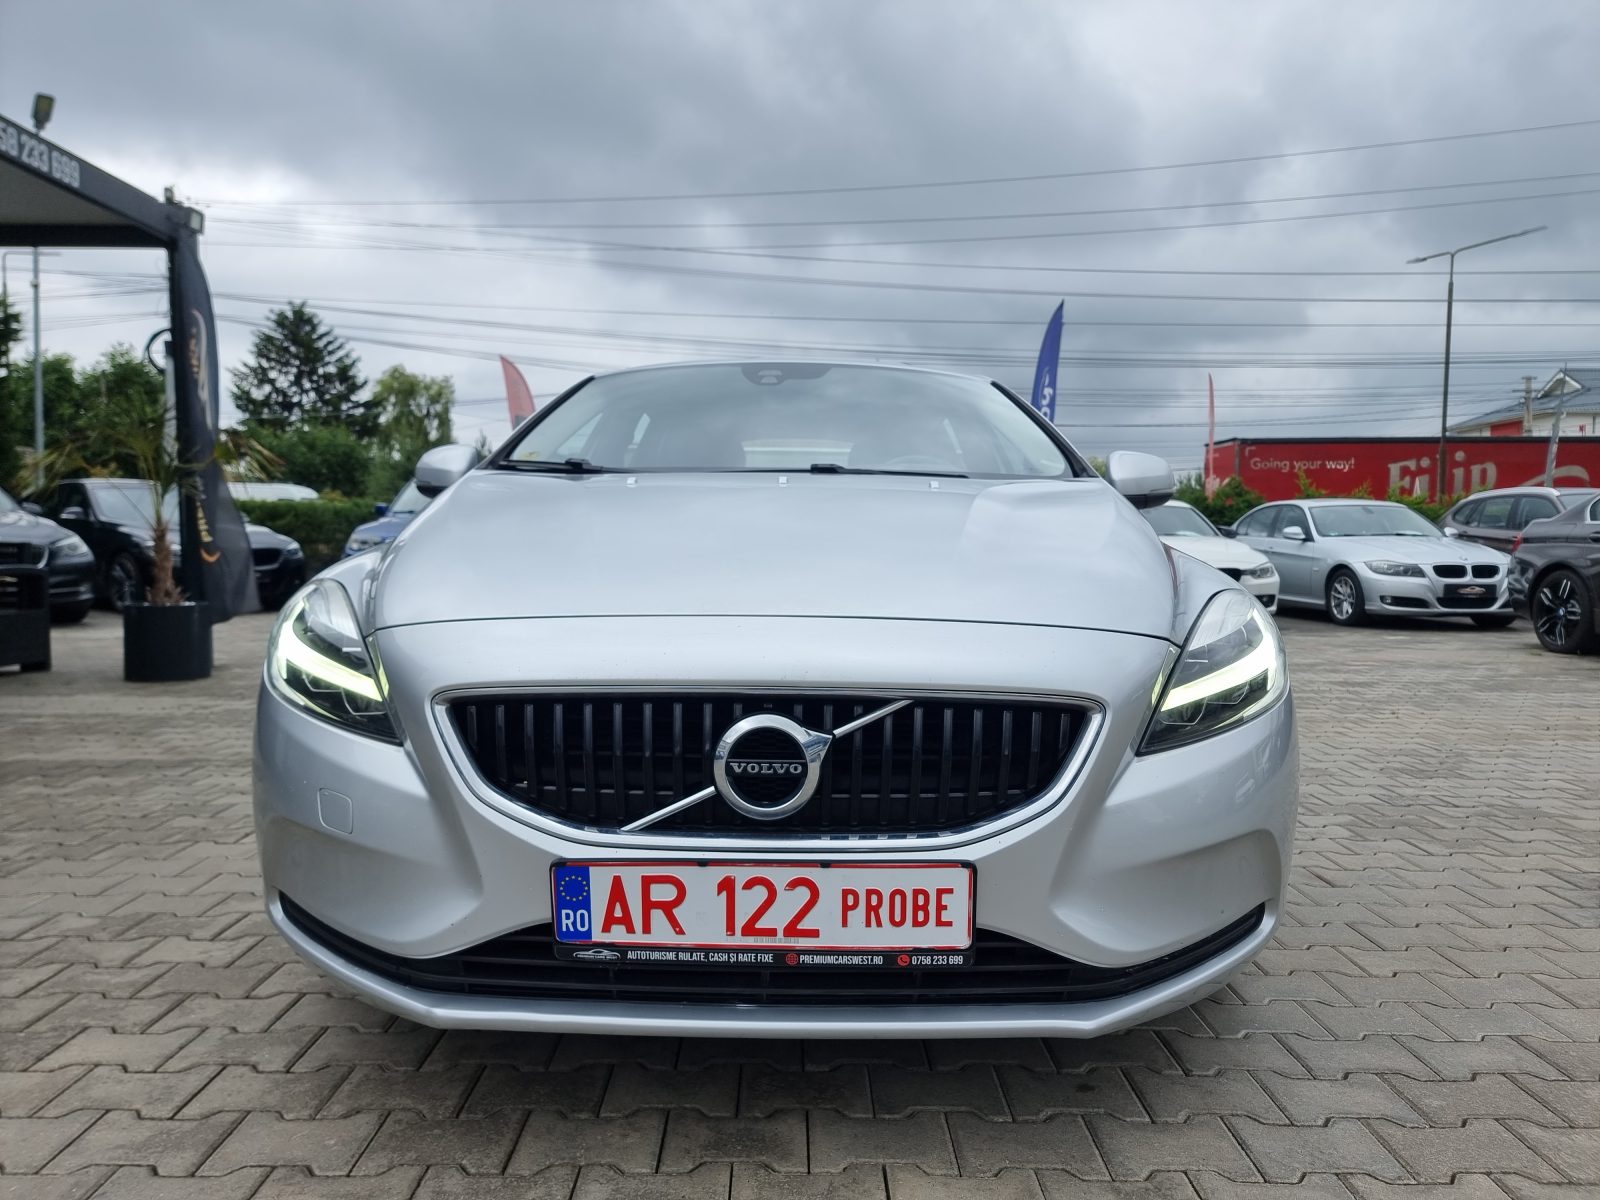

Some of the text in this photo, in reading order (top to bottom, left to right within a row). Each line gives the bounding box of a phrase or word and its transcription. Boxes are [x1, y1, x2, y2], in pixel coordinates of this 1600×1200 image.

[20, 133, 50, 174] 233
[1251, 457, 1355, 473] Going your way!
[729, 762, 803, 774] VOLVO
[601, 875, 954, 938] AR 122 PROBE
[561, 909, 589, 932] RO
[627, 950, 677, 961] AUTOTURISME
[679, 952, 708, 962] RULATE,
[709, 952, 728, 962] CASH
[738, 953, 756, 963] RATE
[758, 953, 774, 963] FIXE
[800, 954, 883, 965] PREMIUMCARSWEST.RO
[911, 955, 963, 965] 0758 233 699
